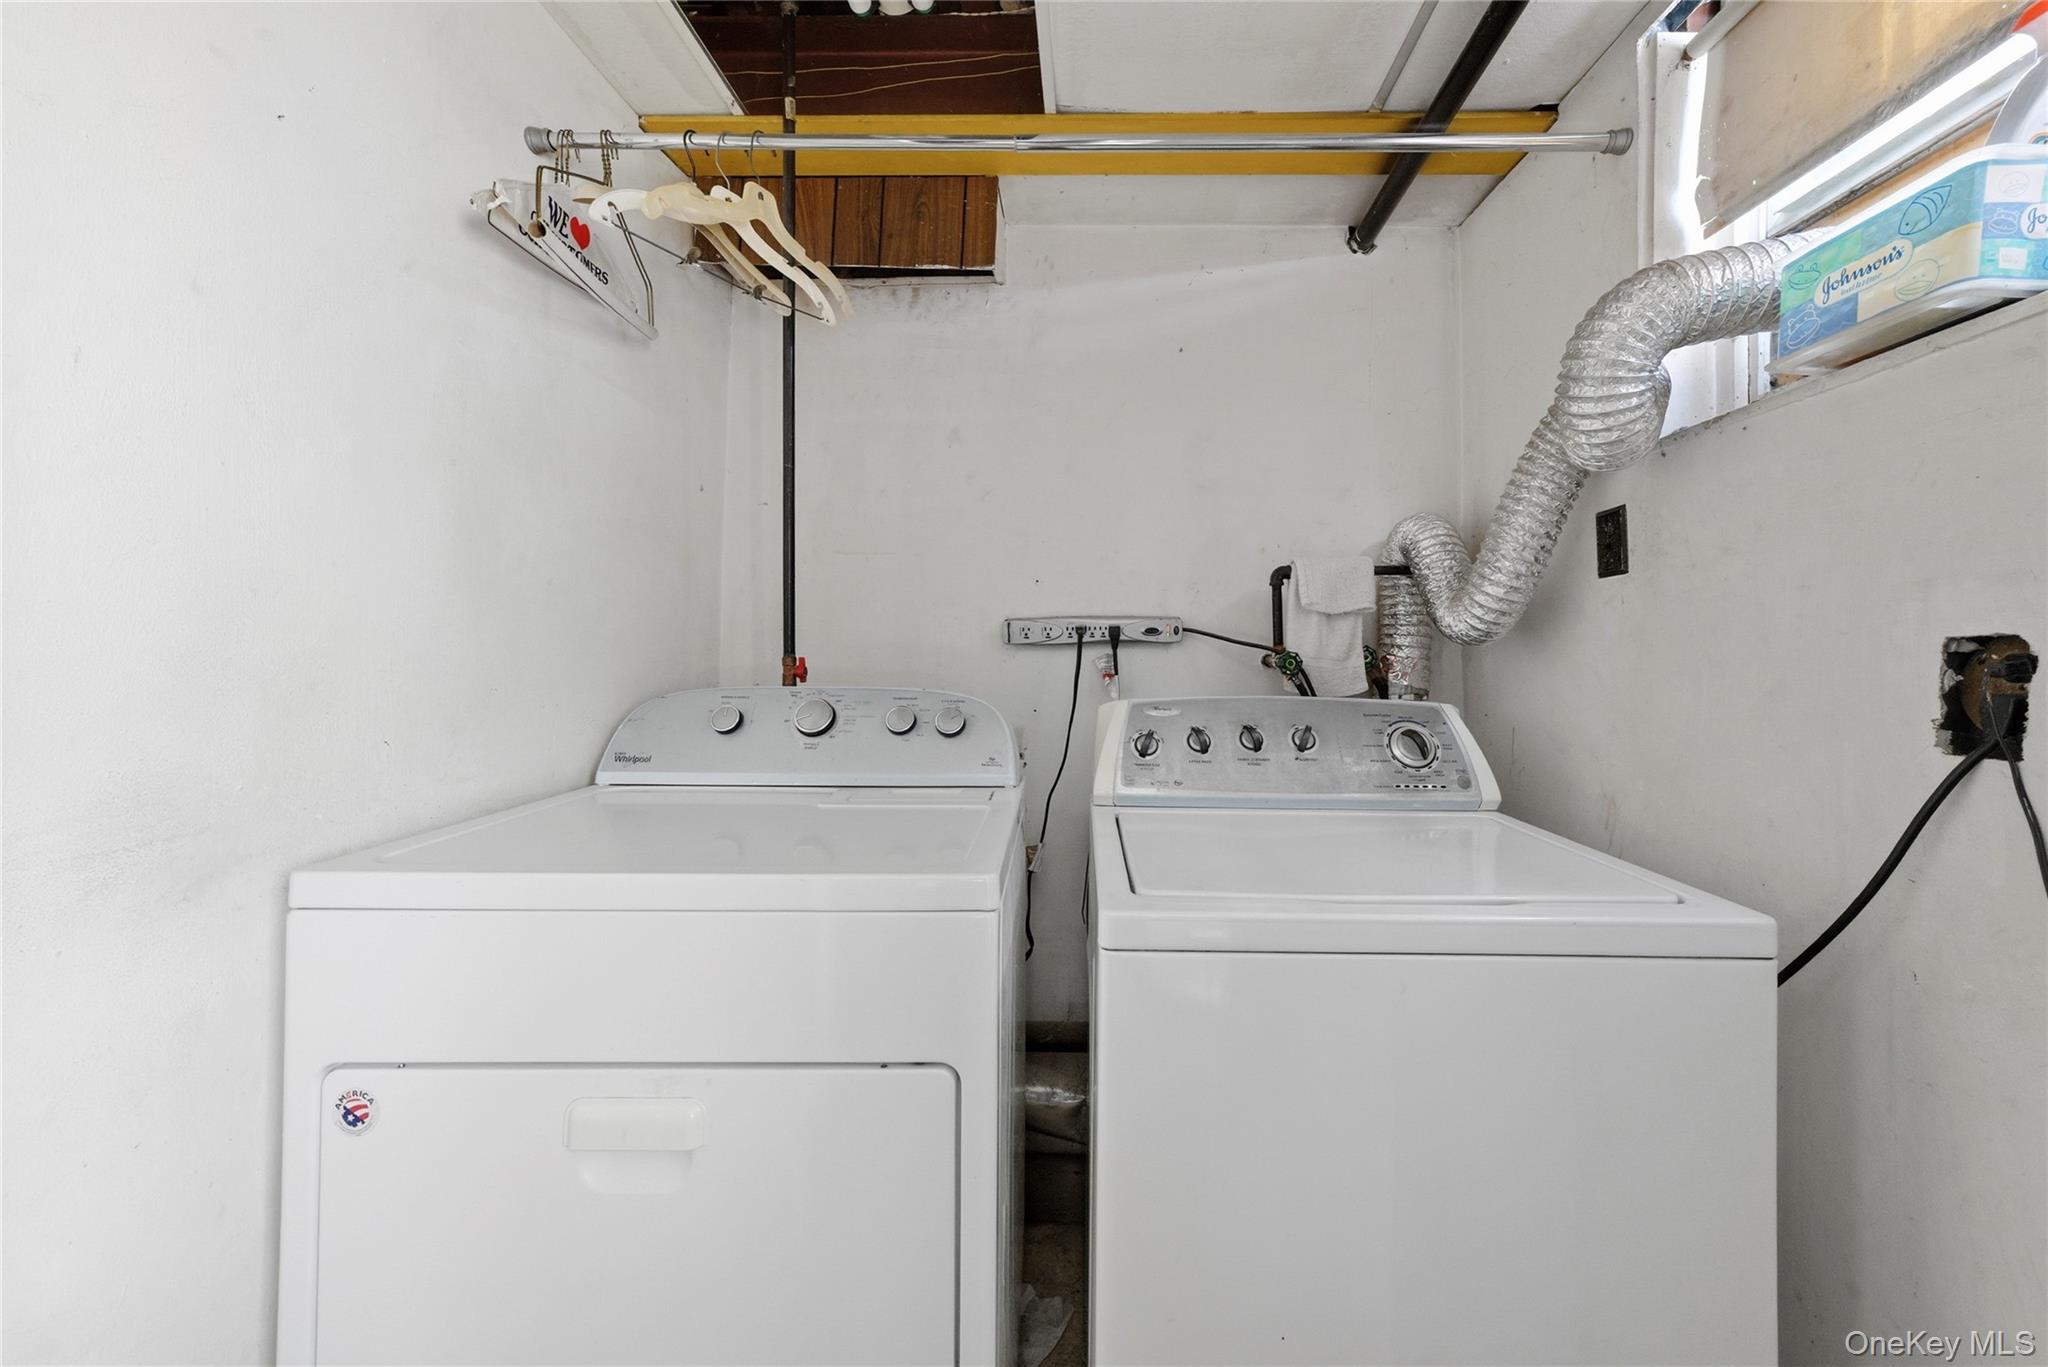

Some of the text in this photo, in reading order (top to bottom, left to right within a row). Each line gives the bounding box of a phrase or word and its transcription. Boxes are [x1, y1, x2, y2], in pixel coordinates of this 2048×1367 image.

[548, 196, 570, 239] WE
[1822, 246, 1904, 304] Johnson's
[614, 755, 652, 764] Whirlpool
[335, 1090, 374, 1110] AMERICA
